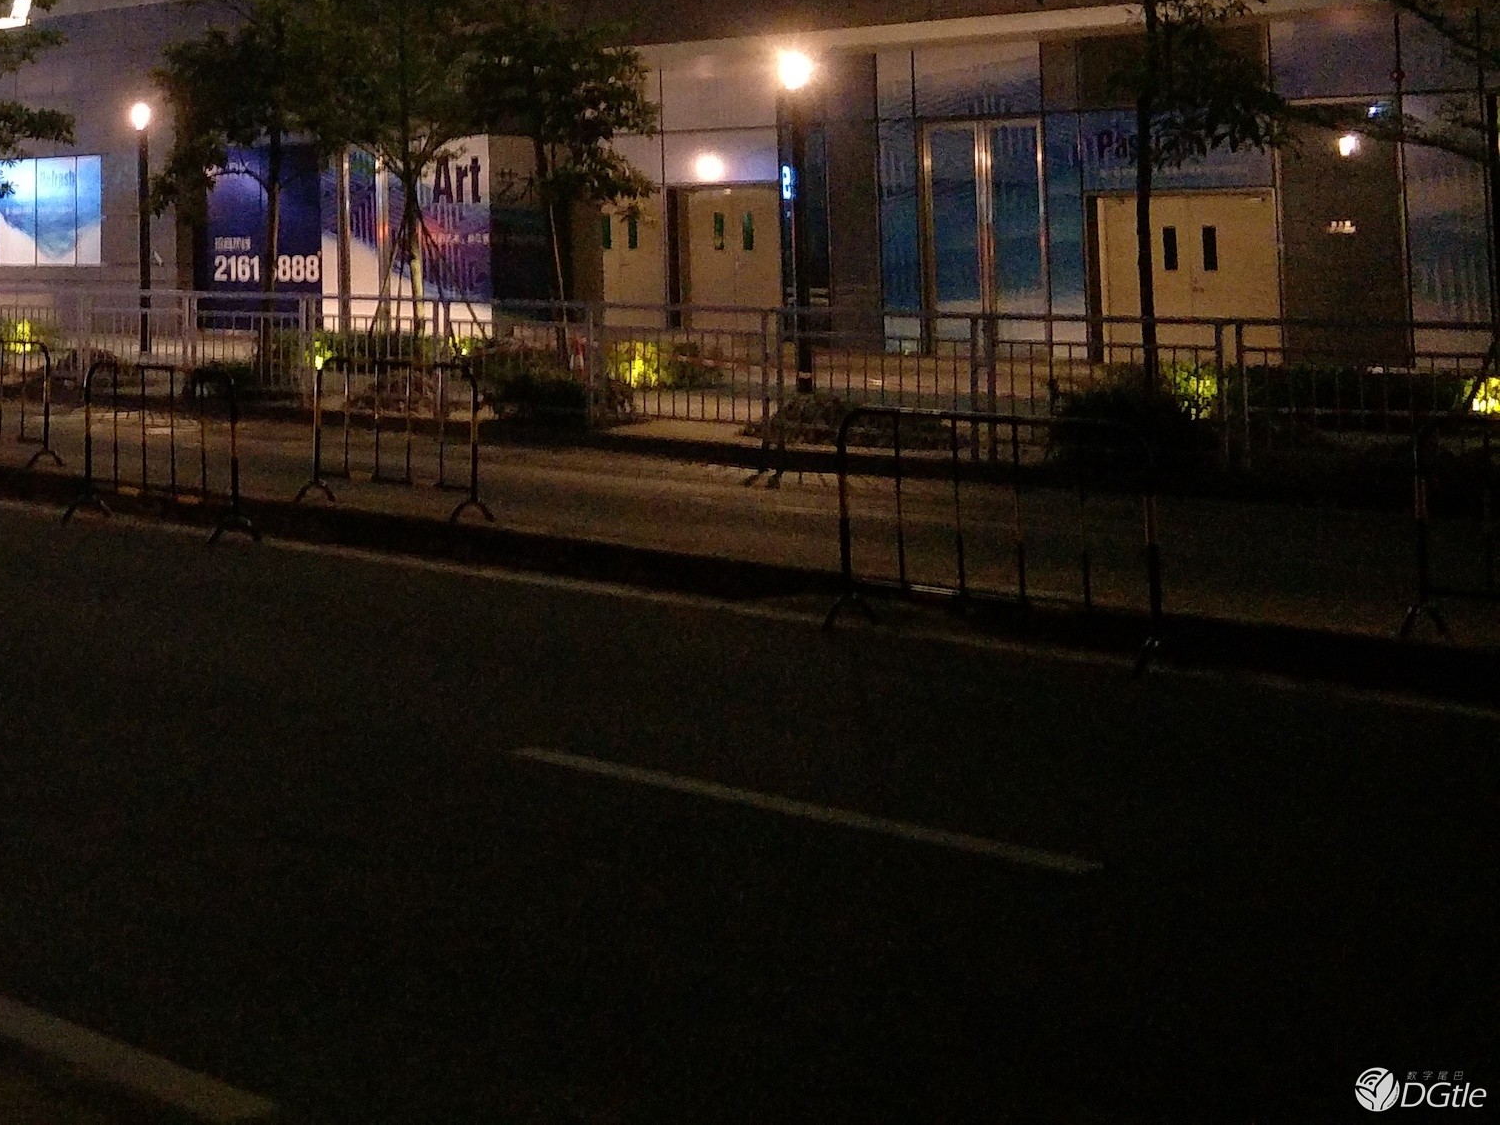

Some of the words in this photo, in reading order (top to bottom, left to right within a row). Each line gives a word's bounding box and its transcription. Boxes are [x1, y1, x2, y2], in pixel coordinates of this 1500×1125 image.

[432, 155, 481, 204] Art
[213, 254, 260, 283] 2161
[273, 254, 320, 284] 888
